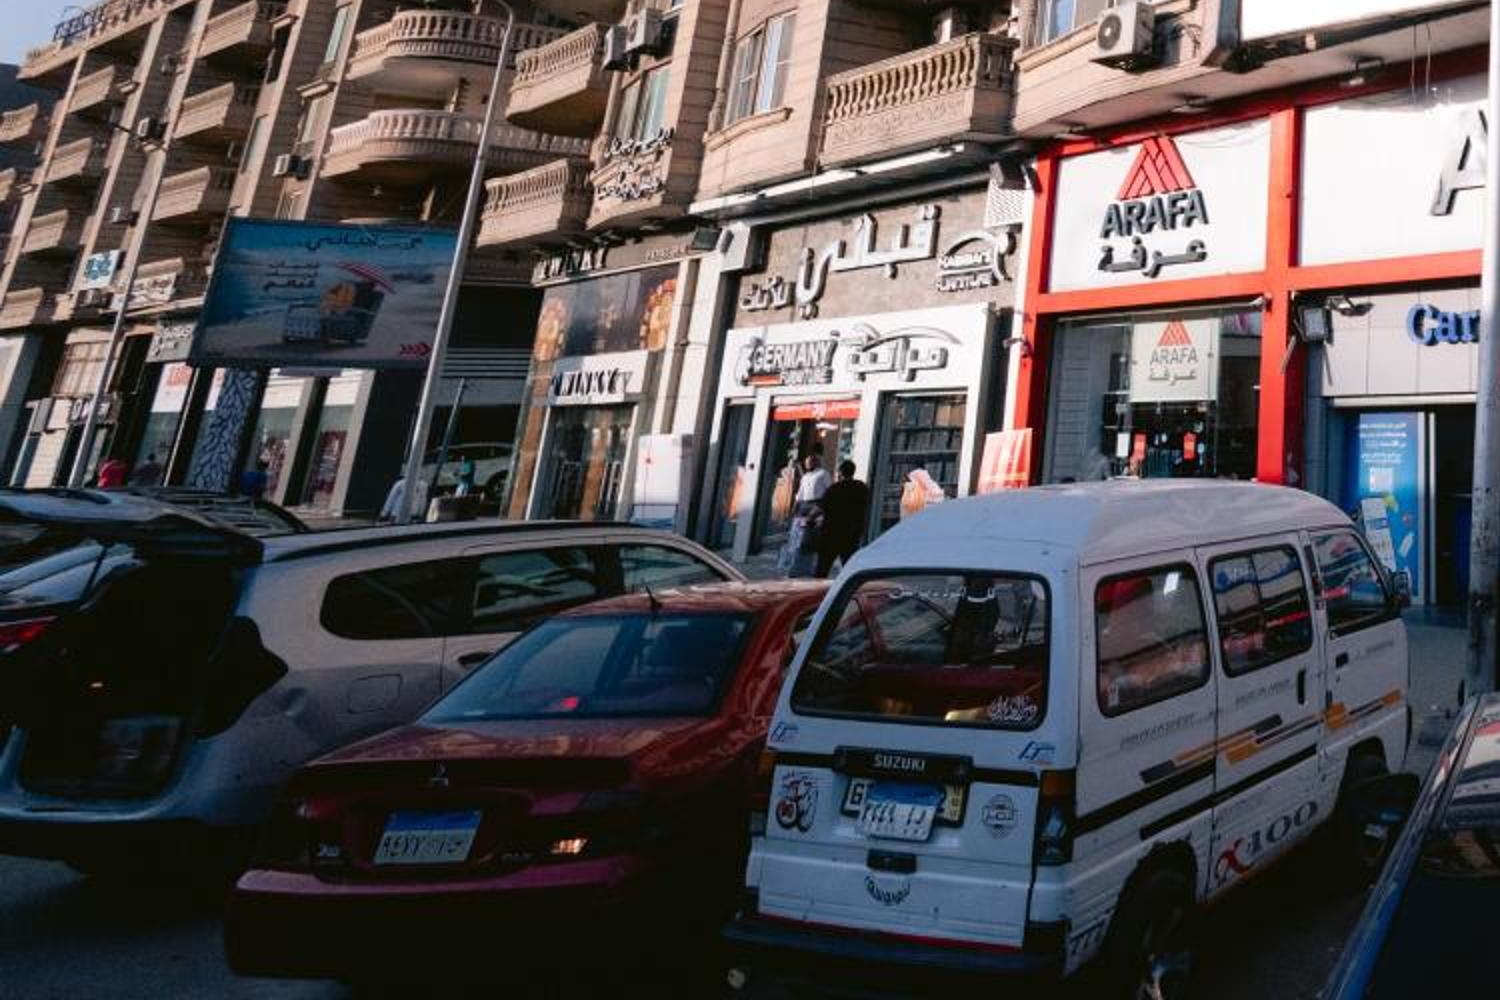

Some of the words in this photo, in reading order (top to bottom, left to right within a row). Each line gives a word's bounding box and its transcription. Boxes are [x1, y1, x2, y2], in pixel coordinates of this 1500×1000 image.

[1099, 189, 1209, 239] ARAFA
[1098, 236, 1208, 279] عرفة
[752, 338, 838, 370] GERMANY
[1149, 347, 1199, 365] ARAFA
[872, 753, 927, 771] SUZUKI
